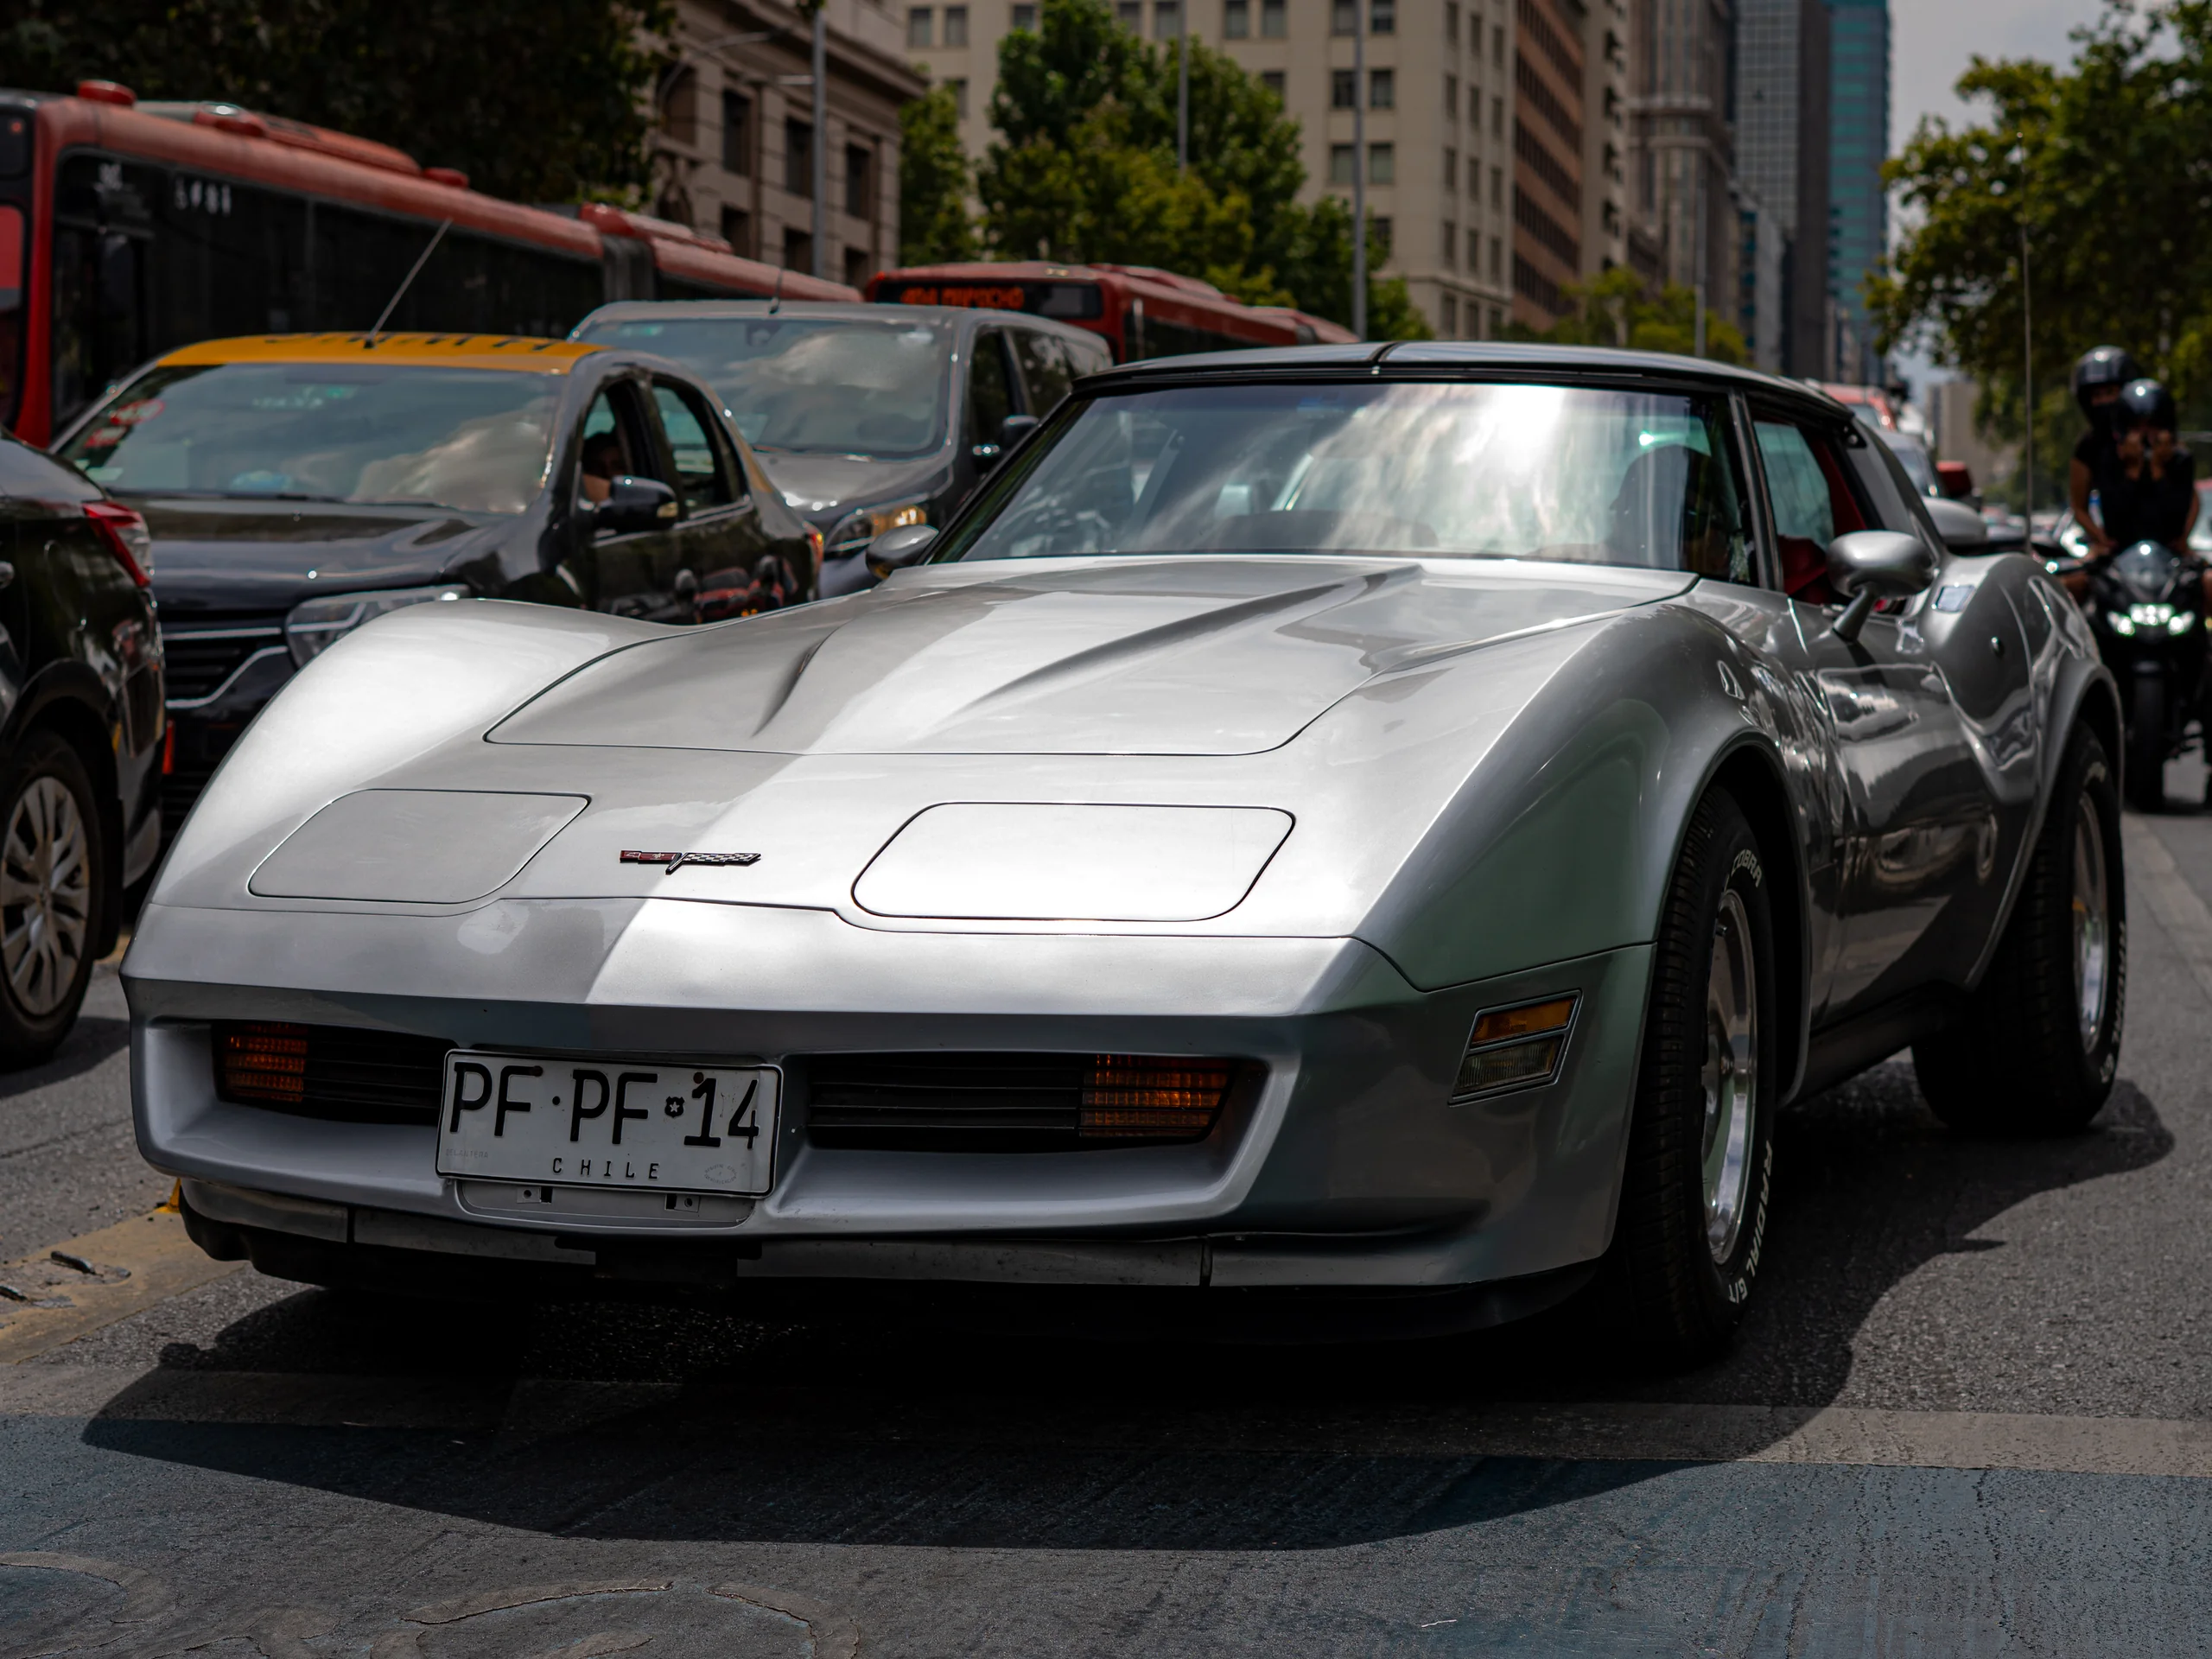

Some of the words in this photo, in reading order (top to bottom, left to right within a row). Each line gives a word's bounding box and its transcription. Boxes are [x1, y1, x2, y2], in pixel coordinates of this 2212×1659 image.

[1731, 849, 1763, 887] COBRA
[552, 1157, 660, 1180] CHILE
[1746, 1140, 1774, 1278] RADIAL
